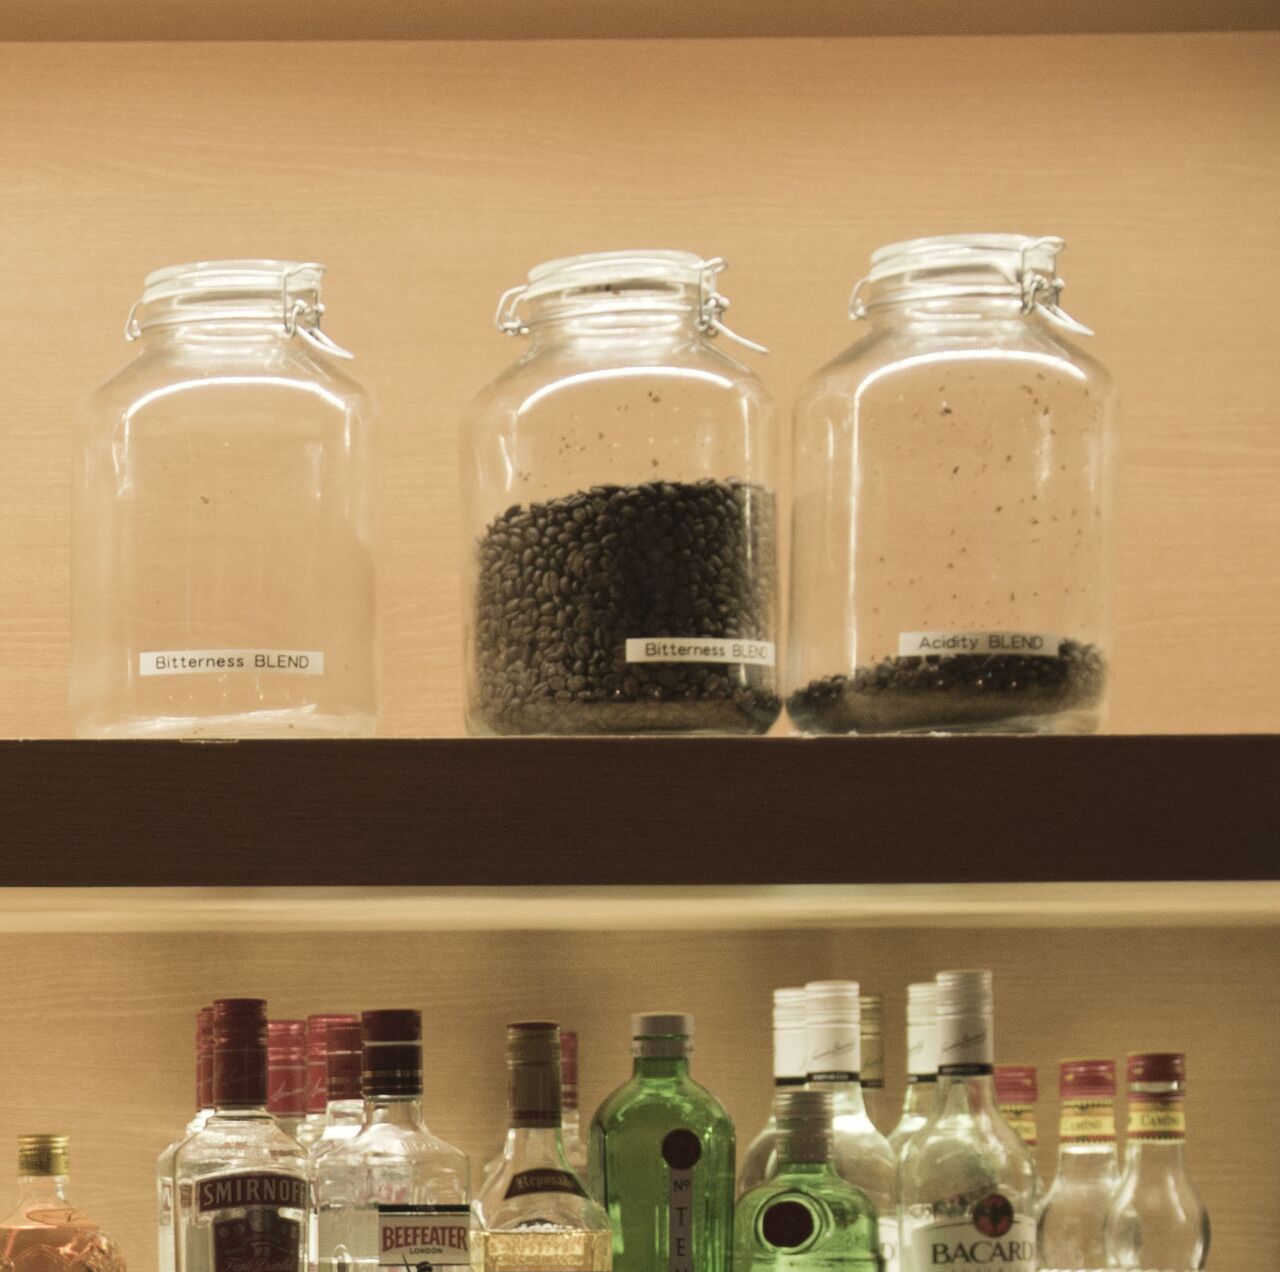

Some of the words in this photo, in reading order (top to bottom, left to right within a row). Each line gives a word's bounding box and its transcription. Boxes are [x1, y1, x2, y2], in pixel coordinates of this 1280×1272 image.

[919, 636, 980, 650] Acidity
[988, 634, 1044, 650] BLEND
[644, 643, 726, 657] Bitterness
[732, 643, 768, 659] BLEND
[155, 656, 245, 669] Bitterness
[254, 654, 309, 669] BLEND
[382, 1225, 468, 1252] BEEFEATER
